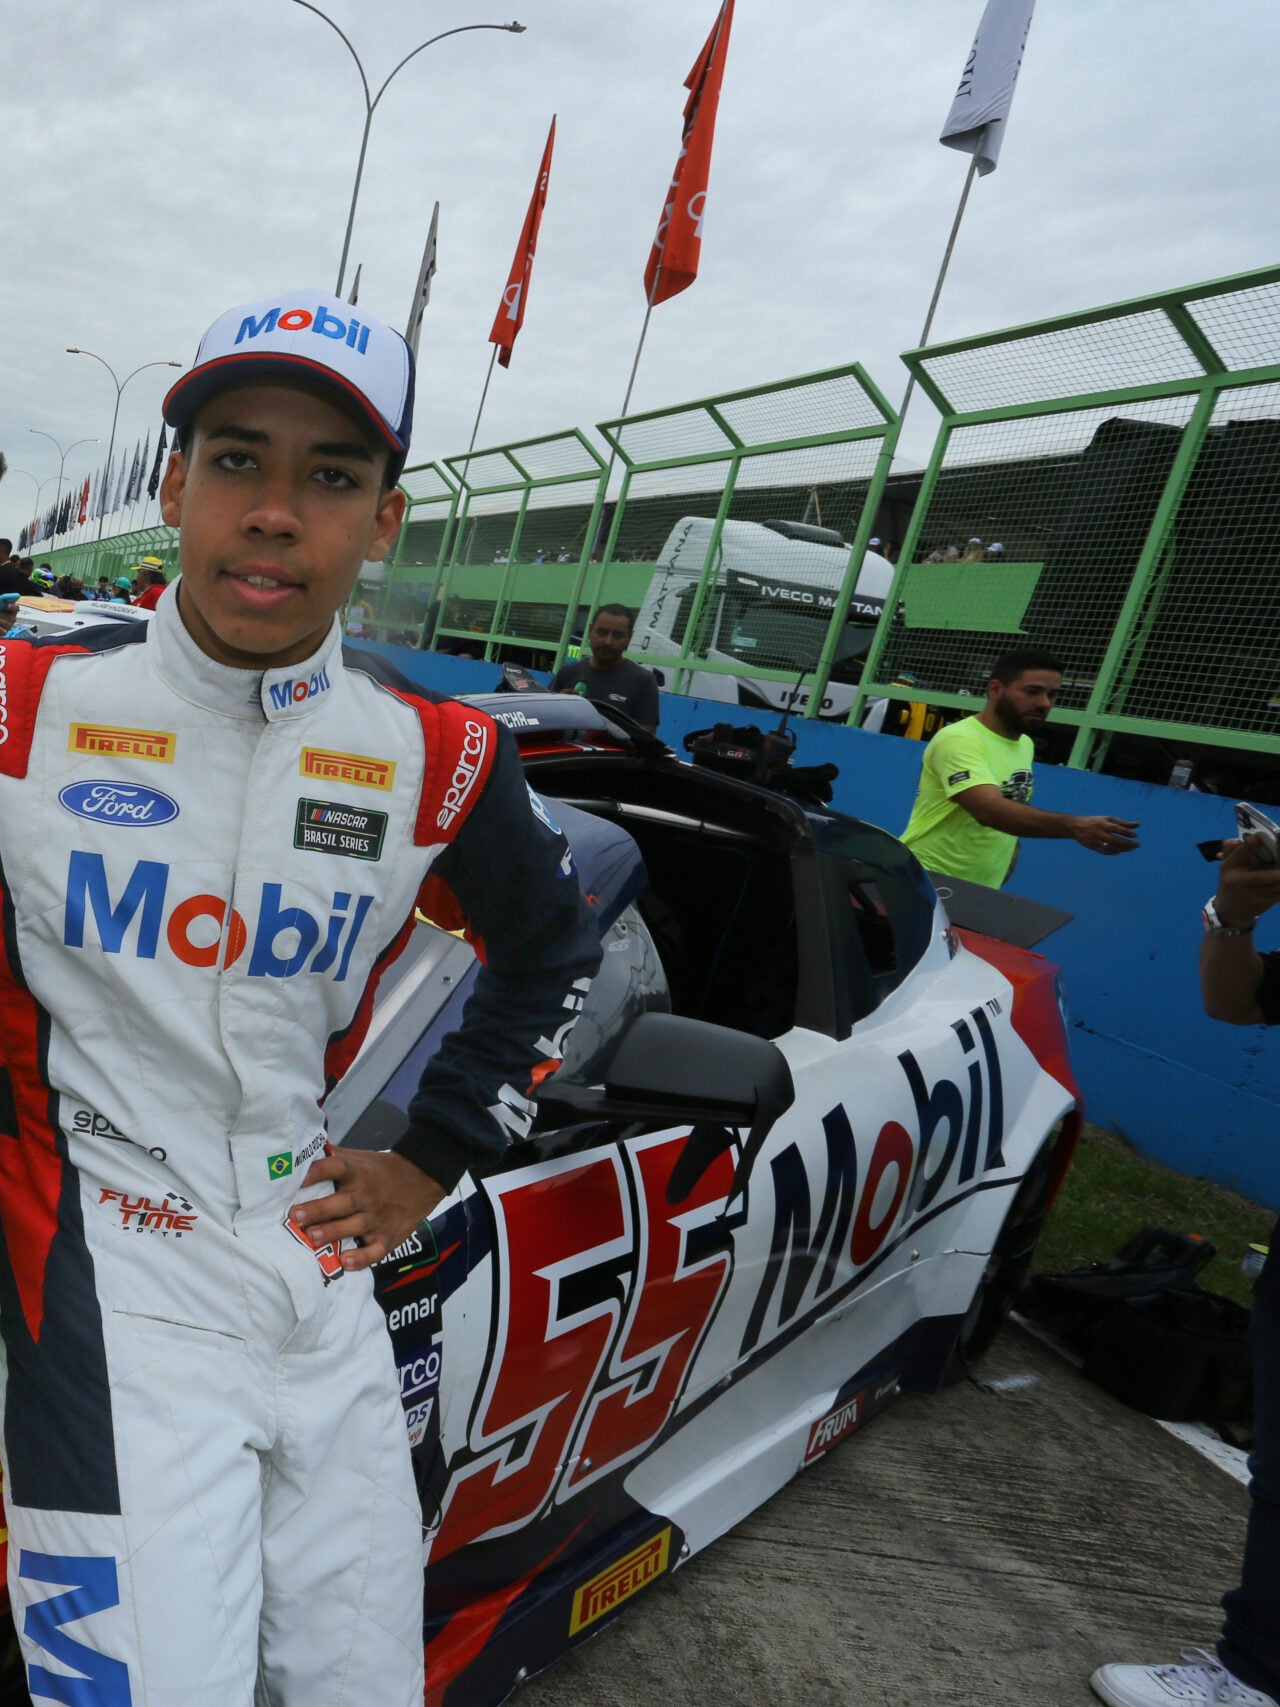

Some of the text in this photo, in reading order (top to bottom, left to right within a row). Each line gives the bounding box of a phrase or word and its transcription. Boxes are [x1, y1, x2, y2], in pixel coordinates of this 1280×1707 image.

[234, 306, 371, 355] Mobil
[761, 585, 814, 604] IVECO
[269, 664, 331, 710] Mobil
[75, 727, 169, 758] PIRELLI
[304, 751, 389, 786] PIRELLI
[436, 720, 486, 831] sparco
[82, 785, 156, 820] Ford
[324, 810, 368, 830] NASCAR
[303, 829, 370, 853] BRASIL SERIES
[64, 850, 375, 982] Mobil
[98, 1187, 179, 1214] FULL
[737, 1006, 1007, 1360] Mobil
[387, 1293, 438, 1332] emar
[426, 1125, 750, 1565] 55
[397, 1350, 441, 1394] rco
[807, 1398, 858, 1455] FRUM
[578, 1536, 663, 1626] PIRELLI
